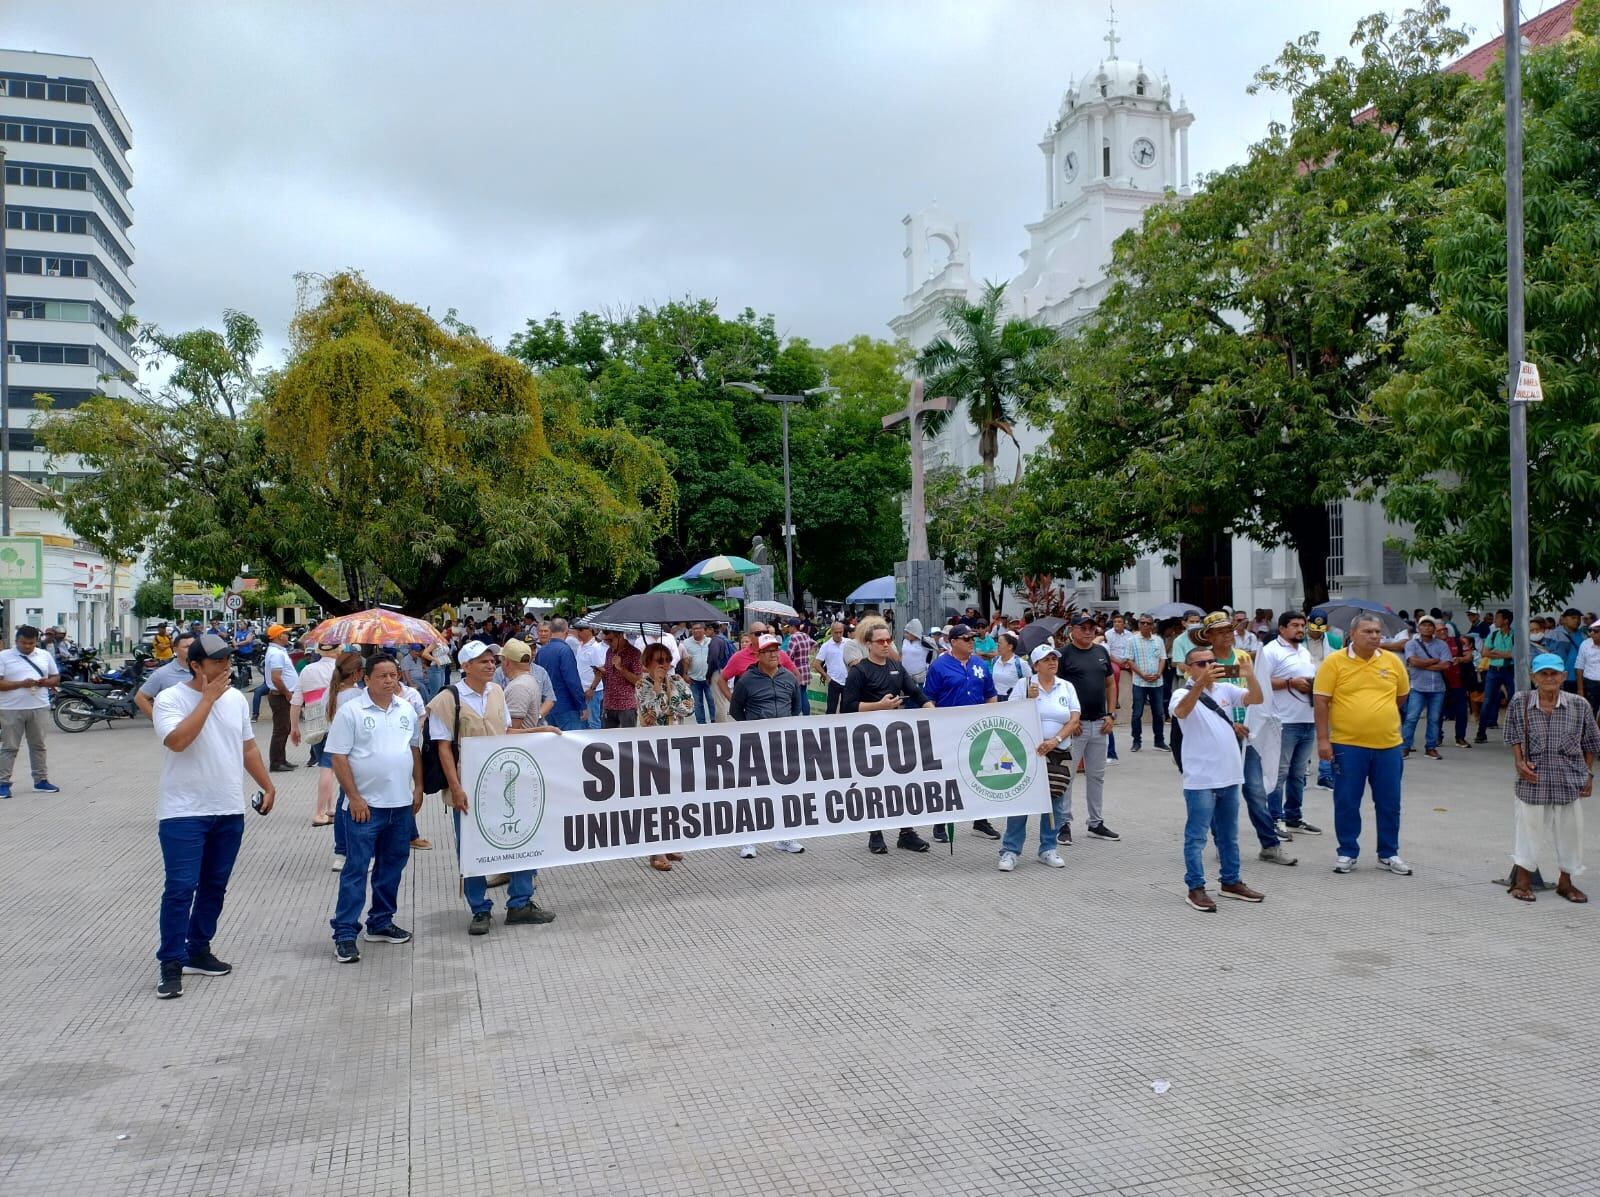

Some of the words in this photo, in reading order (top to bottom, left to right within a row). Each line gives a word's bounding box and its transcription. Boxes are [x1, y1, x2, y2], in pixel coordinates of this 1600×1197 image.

[229, 598, 241, 607] 20
[965, 717, 1023, 741] SINTRAUNICOL
[582, 719, 943, 802] SINTRAUNICOL
[970, 780, 1004, 800] UNIVERSIDAD
[1004, 790, 1012, 799] DE
[564, 797, 775, 852] UNIVERSIDAD
[782, 792, 819, 829] DE
[825, 779, 964, 824] CÓRDOBA
